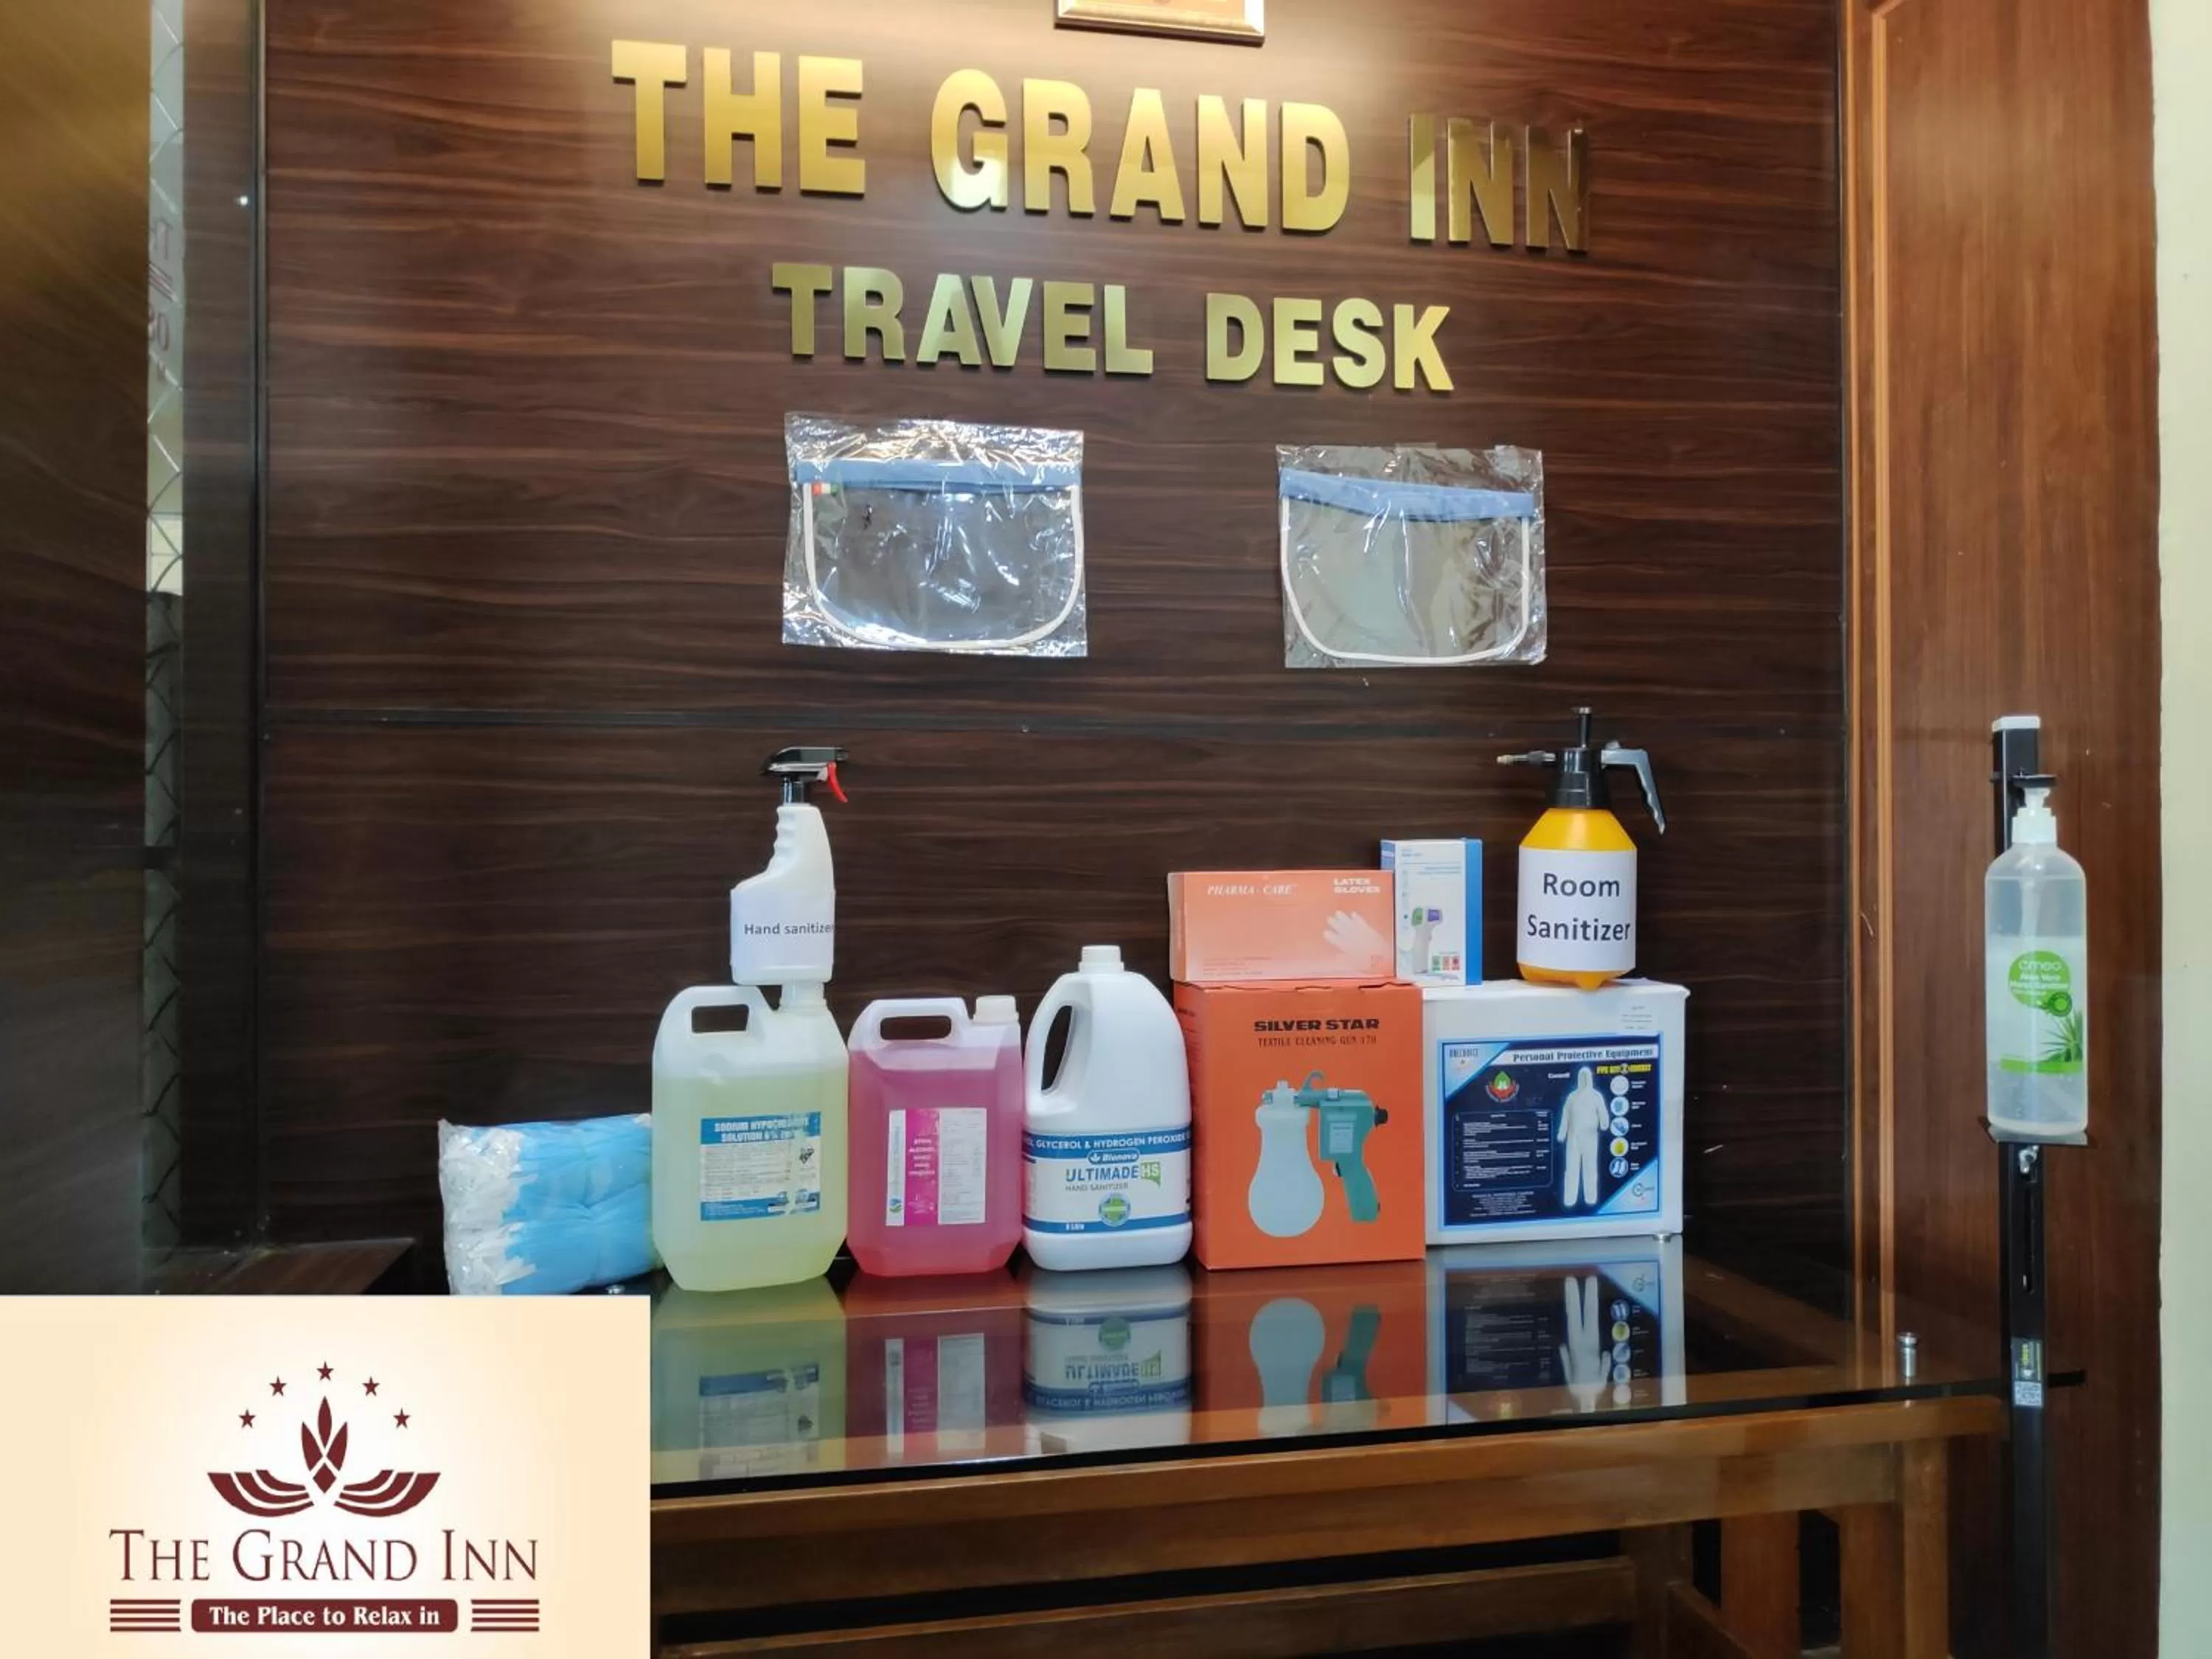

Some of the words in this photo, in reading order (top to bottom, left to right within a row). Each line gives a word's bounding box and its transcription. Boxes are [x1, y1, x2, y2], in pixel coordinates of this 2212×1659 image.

[611, 39, 866, 197] THE
[930, 69, 1351, 234] GRAND
[1407, 113, 1589, 251] INN
[772, 263, 1153, 375] TRAVEL
[1206, 292, 1453, 392] DESK
[1543, 872, 1621, 898] Room
[744, 922, 780, 935] Hand
[1527, 914, 1632, 942] Sanitizer
[1254, 1020, 1321, 1032] SILVER
[1325, 1018, 1380, 1030] STAR
[1258, 1037, 1290, 1047] TEXTILE
[1513, 1051, 1554, 1062] Personal
[1557, 1050, 1603, 1061] Protective
[1605, 1048, 1654, 1060] Equipment
[1036, 1138, 1082, 1150] GLYCEROL
[1085, 1141, 1091, 1150] &
[1093, 1138, 1145, 1149] HYDROGEN
[1065, 1165, 1139, 1182] ULTIMADE
[1141, 1163, 1160, 1178] HS
